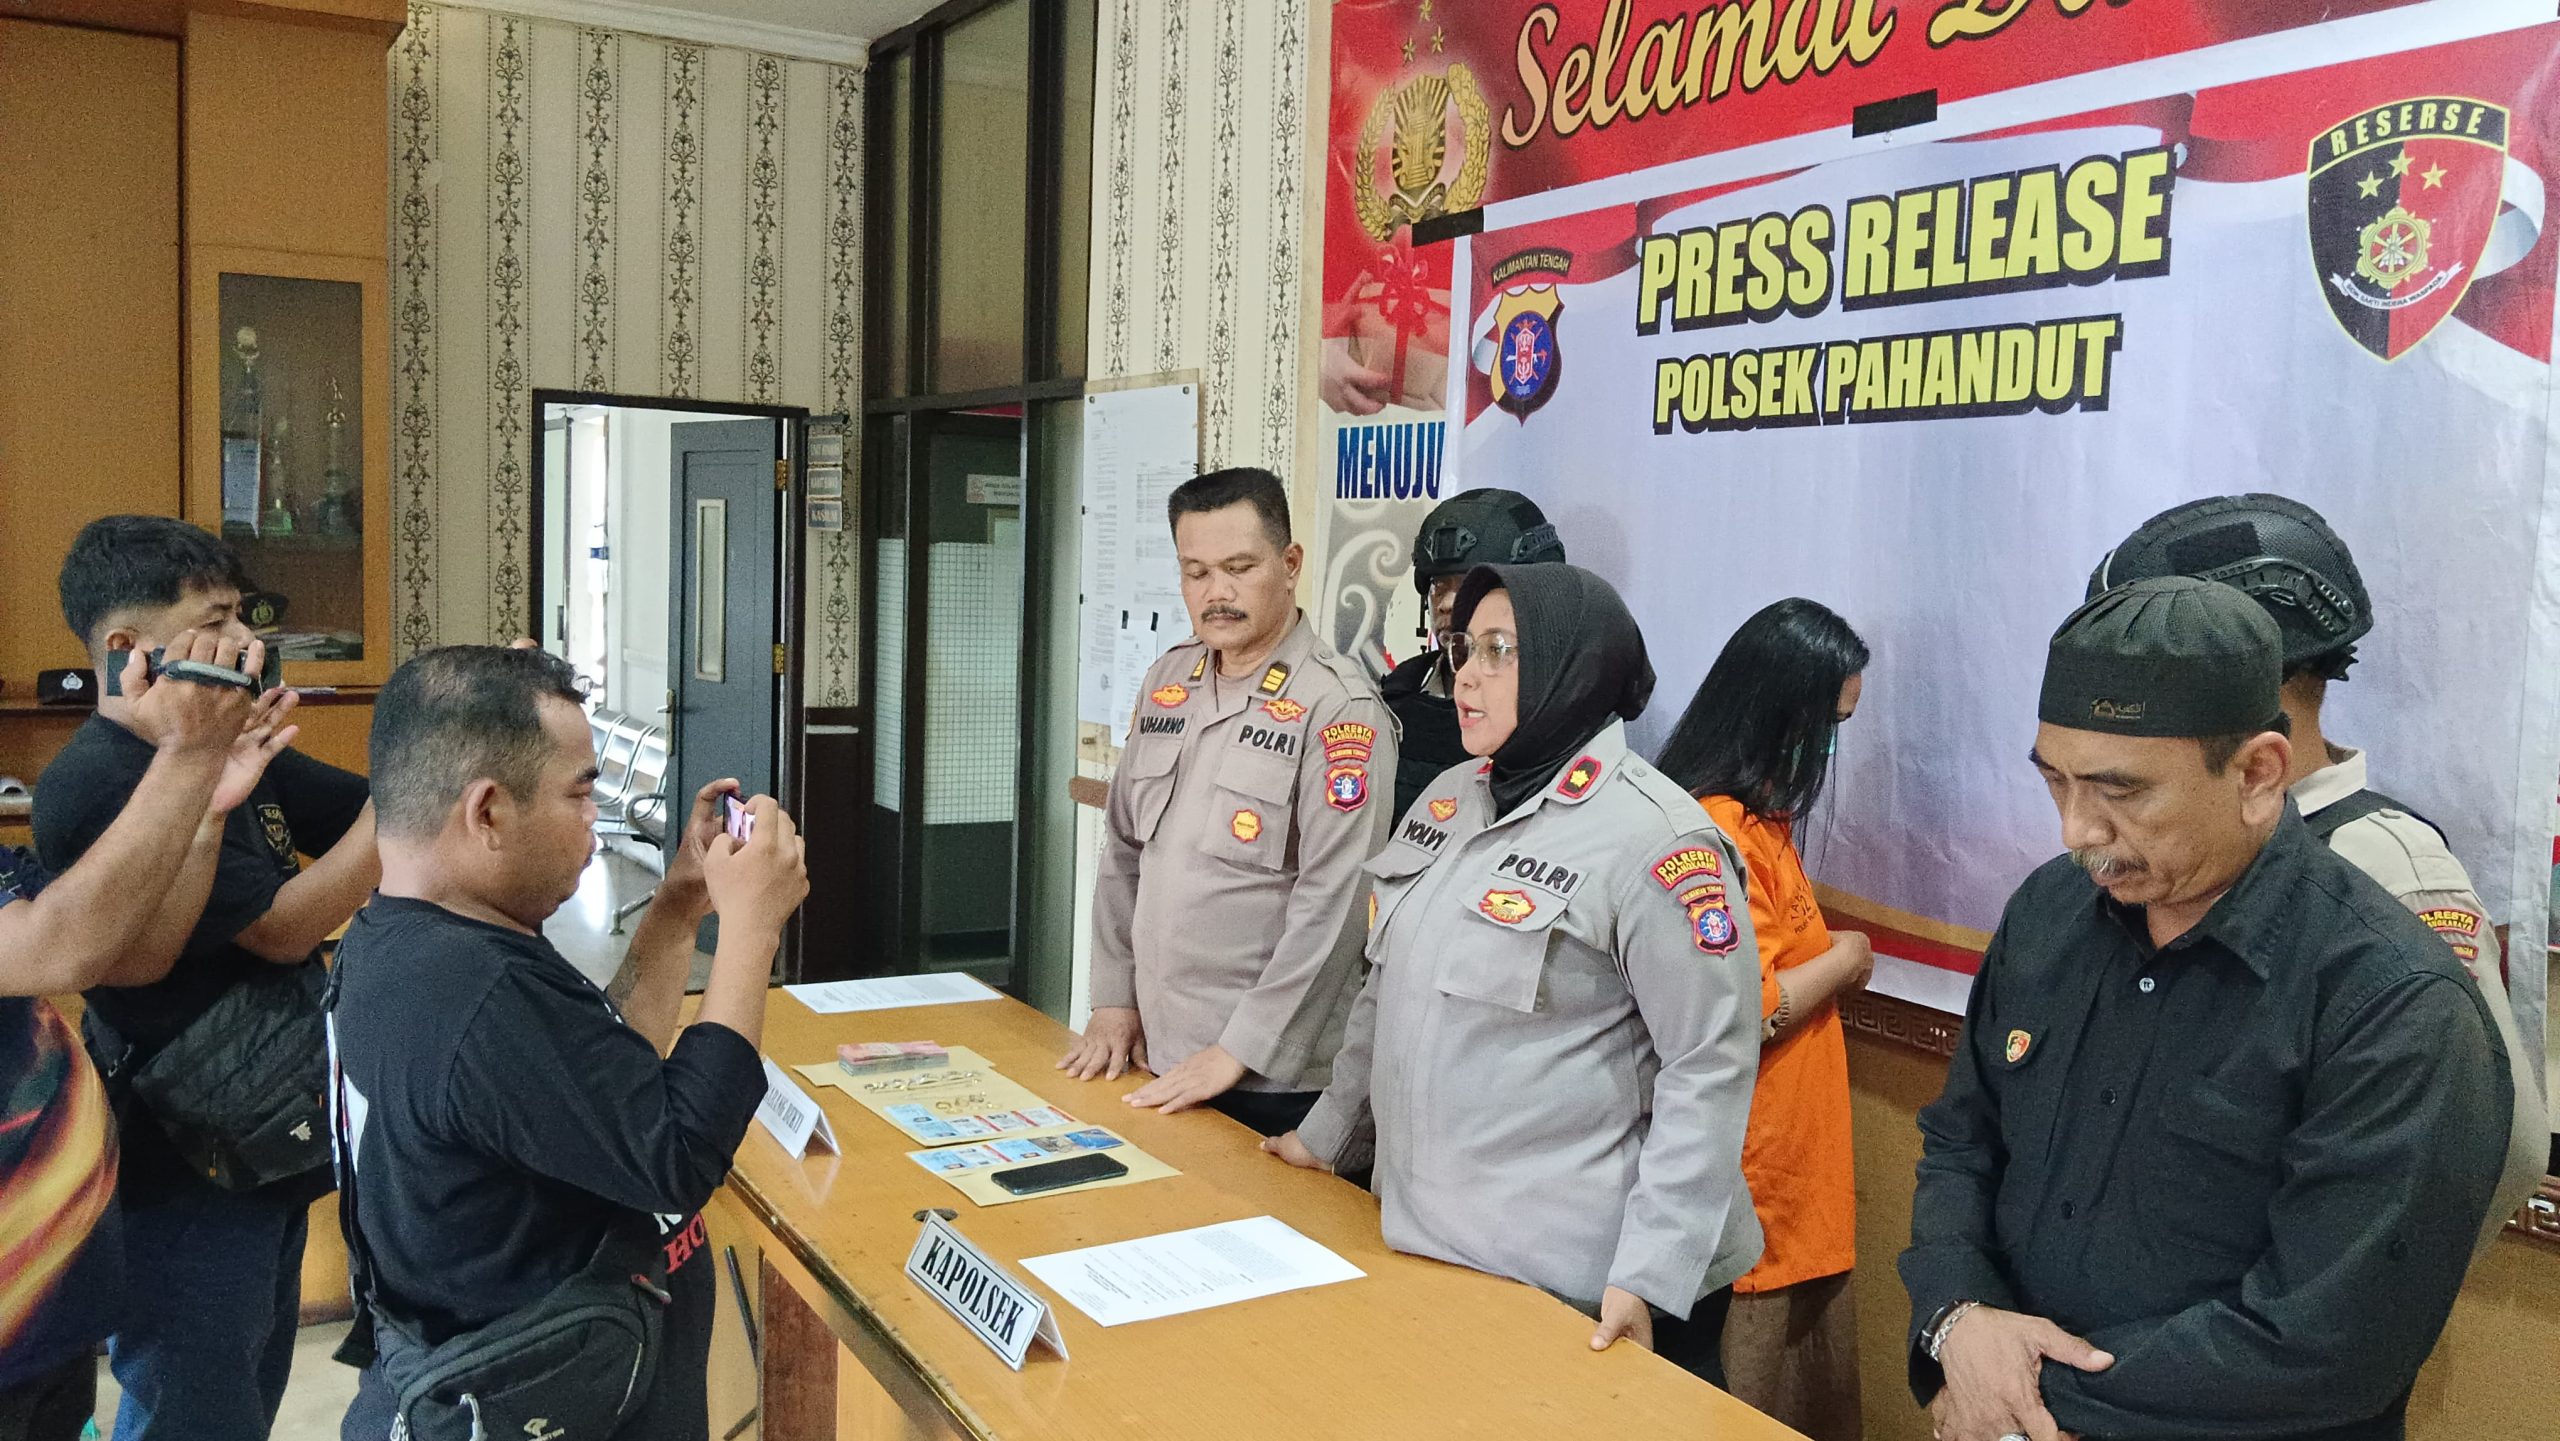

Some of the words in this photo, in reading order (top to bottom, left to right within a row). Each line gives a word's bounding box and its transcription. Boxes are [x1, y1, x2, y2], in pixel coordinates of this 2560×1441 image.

[2330, 103, 2485, 156] RESERSE
[1638, 206, 1833, 333] PRESS
[1843, 147, 2175, 309] RELEASE
[1493, 254, 1539, 284] KALIMANTAN
[1540, 253, 1570, 272] TENGAH
[1654, 344, 1821, 433] POLSEK
[1822, 315, 2120, 423] PAHANDUT
[1336, 421, 1445, 499] MENUJU
[1239, 724, 1297, 756] POLRI
[1323, 723, 1374, 739] POLRESTA
[1498, 854, 1579, 894] POLRI
[1656, 850, 1717, 876] POLRESTA
[920, 1235, 1025, 1346] KAPOLSEK
